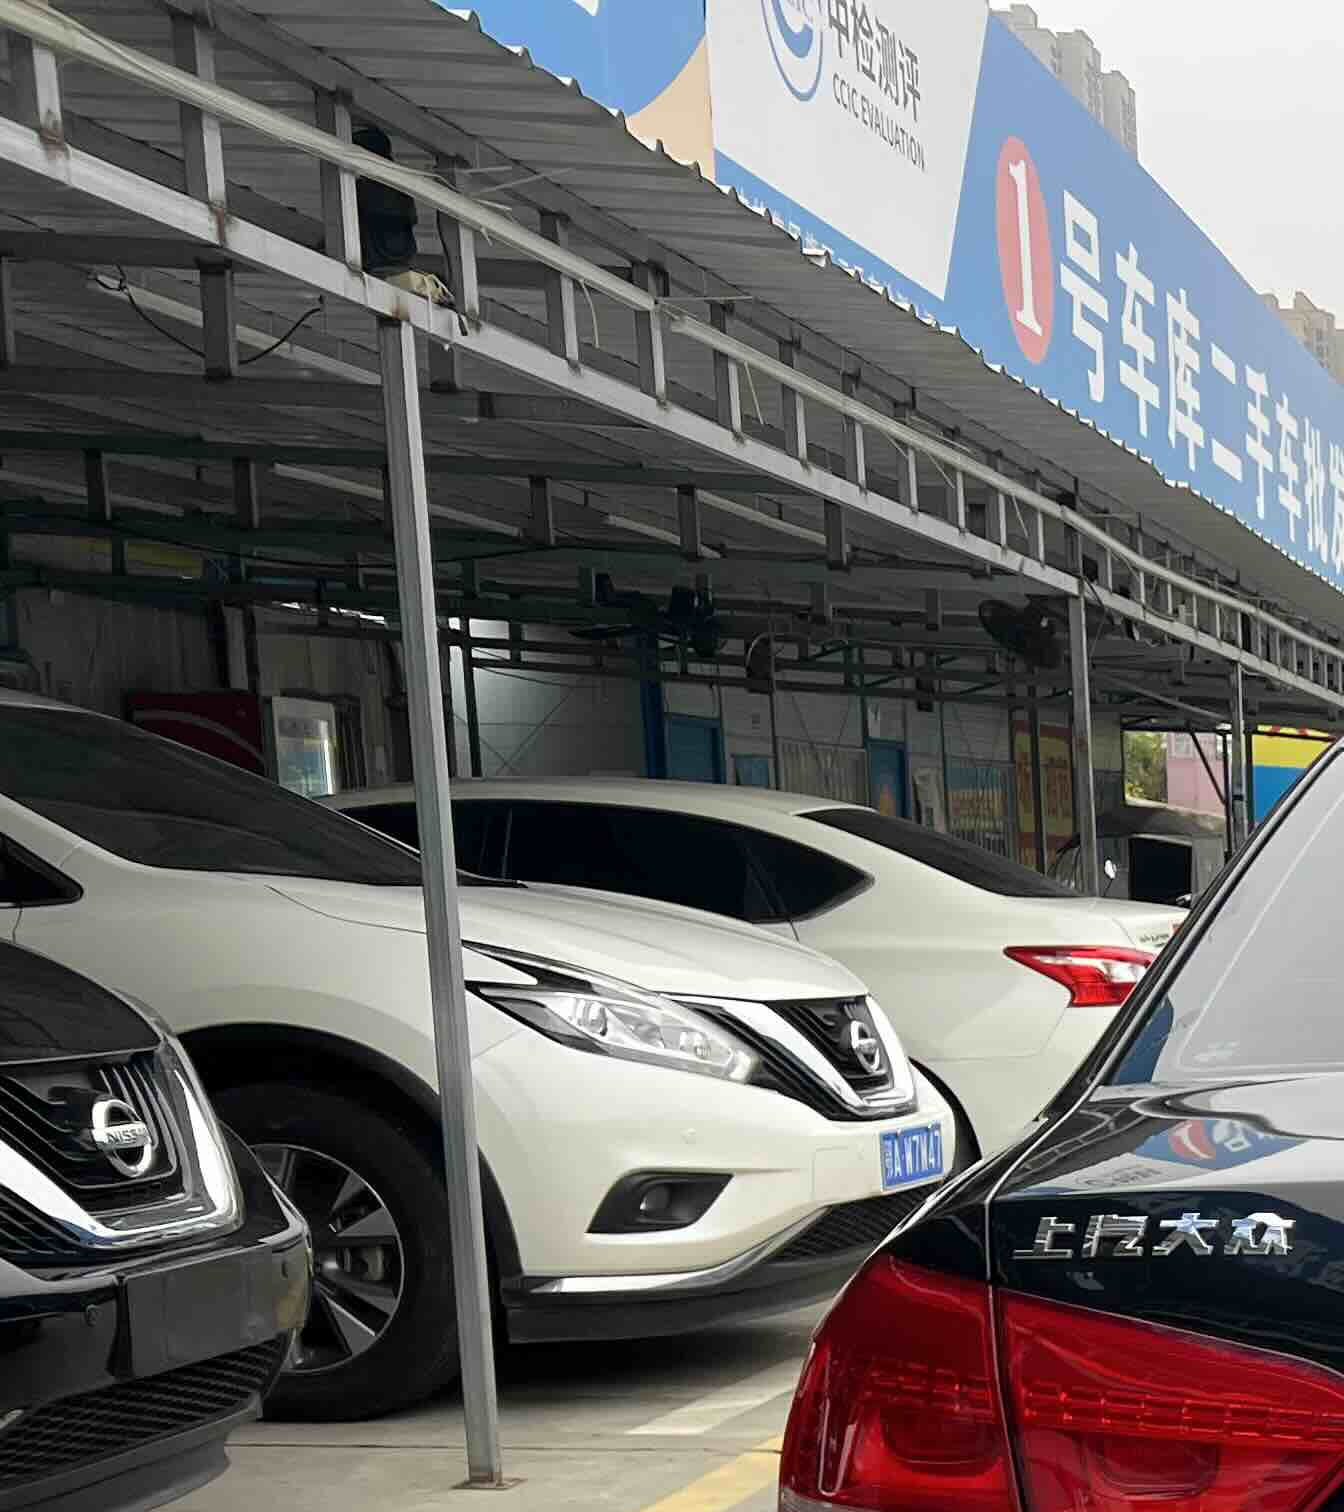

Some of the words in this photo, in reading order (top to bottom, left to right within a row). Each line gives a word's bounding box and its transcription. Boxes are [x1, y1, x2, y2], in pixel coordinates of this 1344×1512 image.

[833, 72, 860, 119] CCIC
[861, 94, 925, 172] EVALUATION
[1012, 1212, 1297, 1260] 上汽大众
